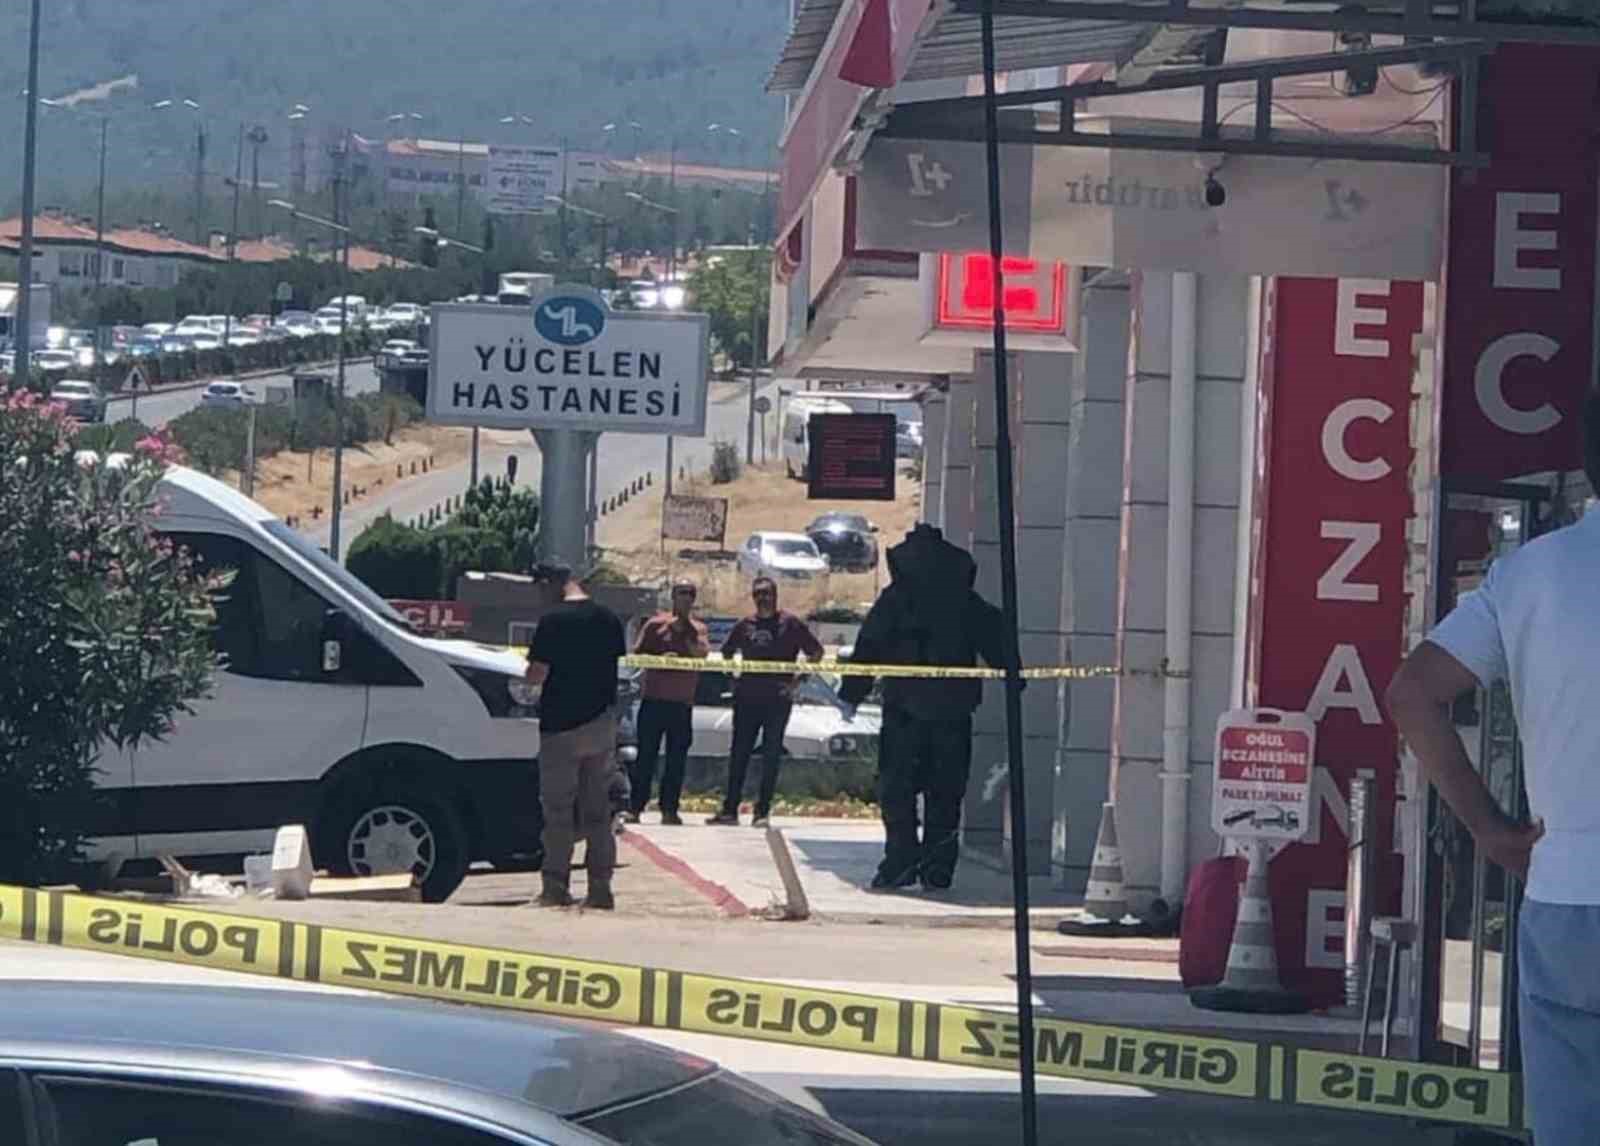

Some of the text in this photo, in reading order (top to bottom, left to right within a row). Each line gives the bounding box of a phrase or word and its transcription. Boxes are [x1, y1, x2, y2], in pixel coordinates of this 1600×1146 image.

[474, 337, 662, 379] YÜCELEN
[452, 381, 681, 417] HASTANESİ
[403, 604, 465, 628] CİL
